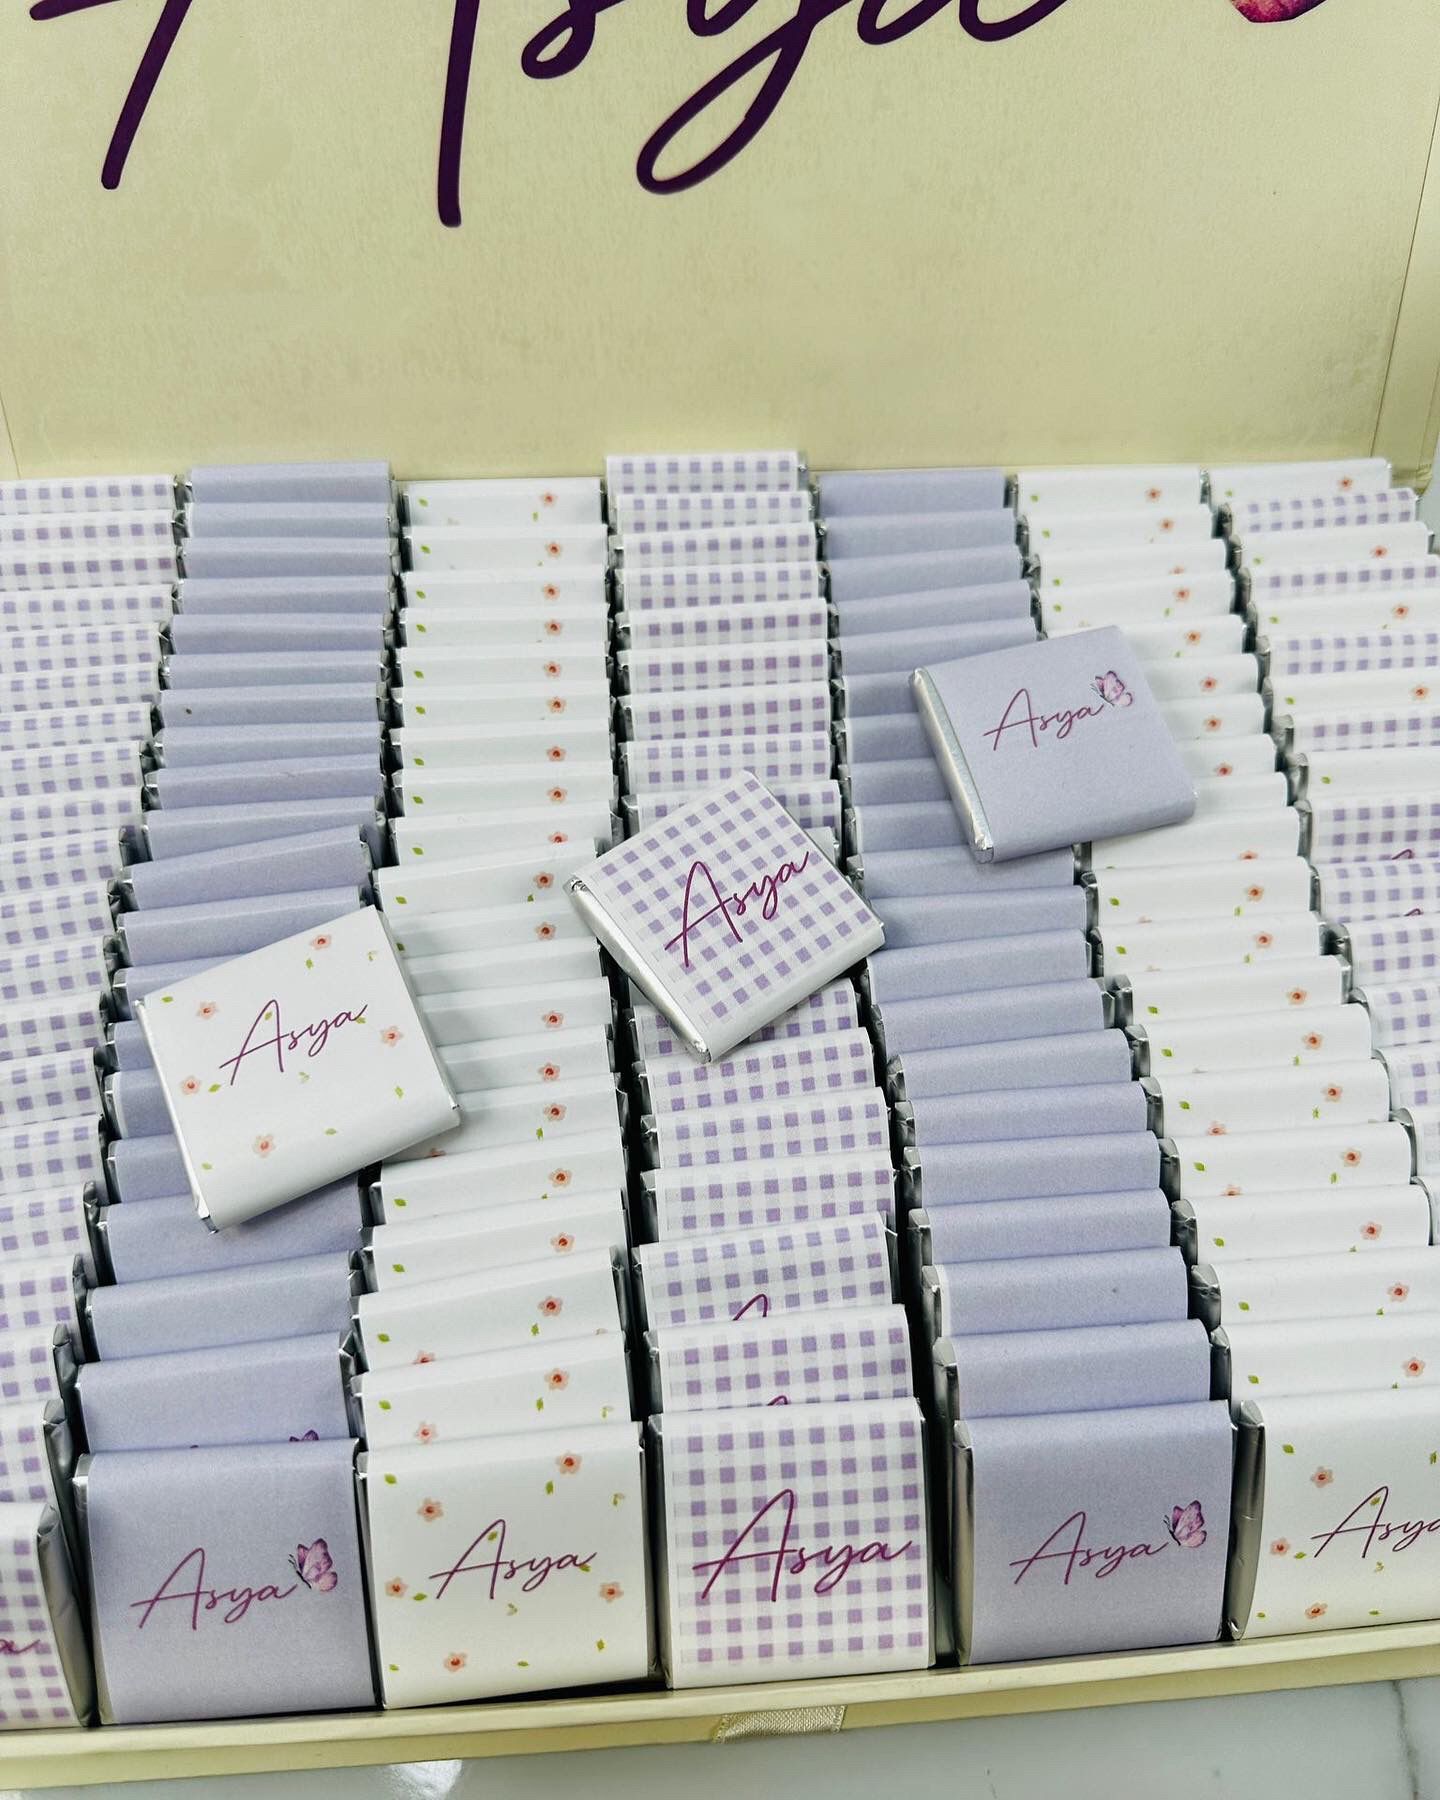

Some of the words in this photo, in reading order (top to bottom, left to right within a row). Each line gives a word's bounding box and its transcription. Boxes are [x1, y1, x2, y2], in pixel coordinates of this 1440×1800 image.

[982, 688, 1104, 750] Asya
[664, 851, 809, 967] Asya
[218, 999, 368, 1086] Asya
[429, 1518, 597, 1599] Asya
[692, 1488, 912, 1602] Asya
[1010, 1511, 1169, 1585] Asya
[130, 1547, 297, 1629] Asya
